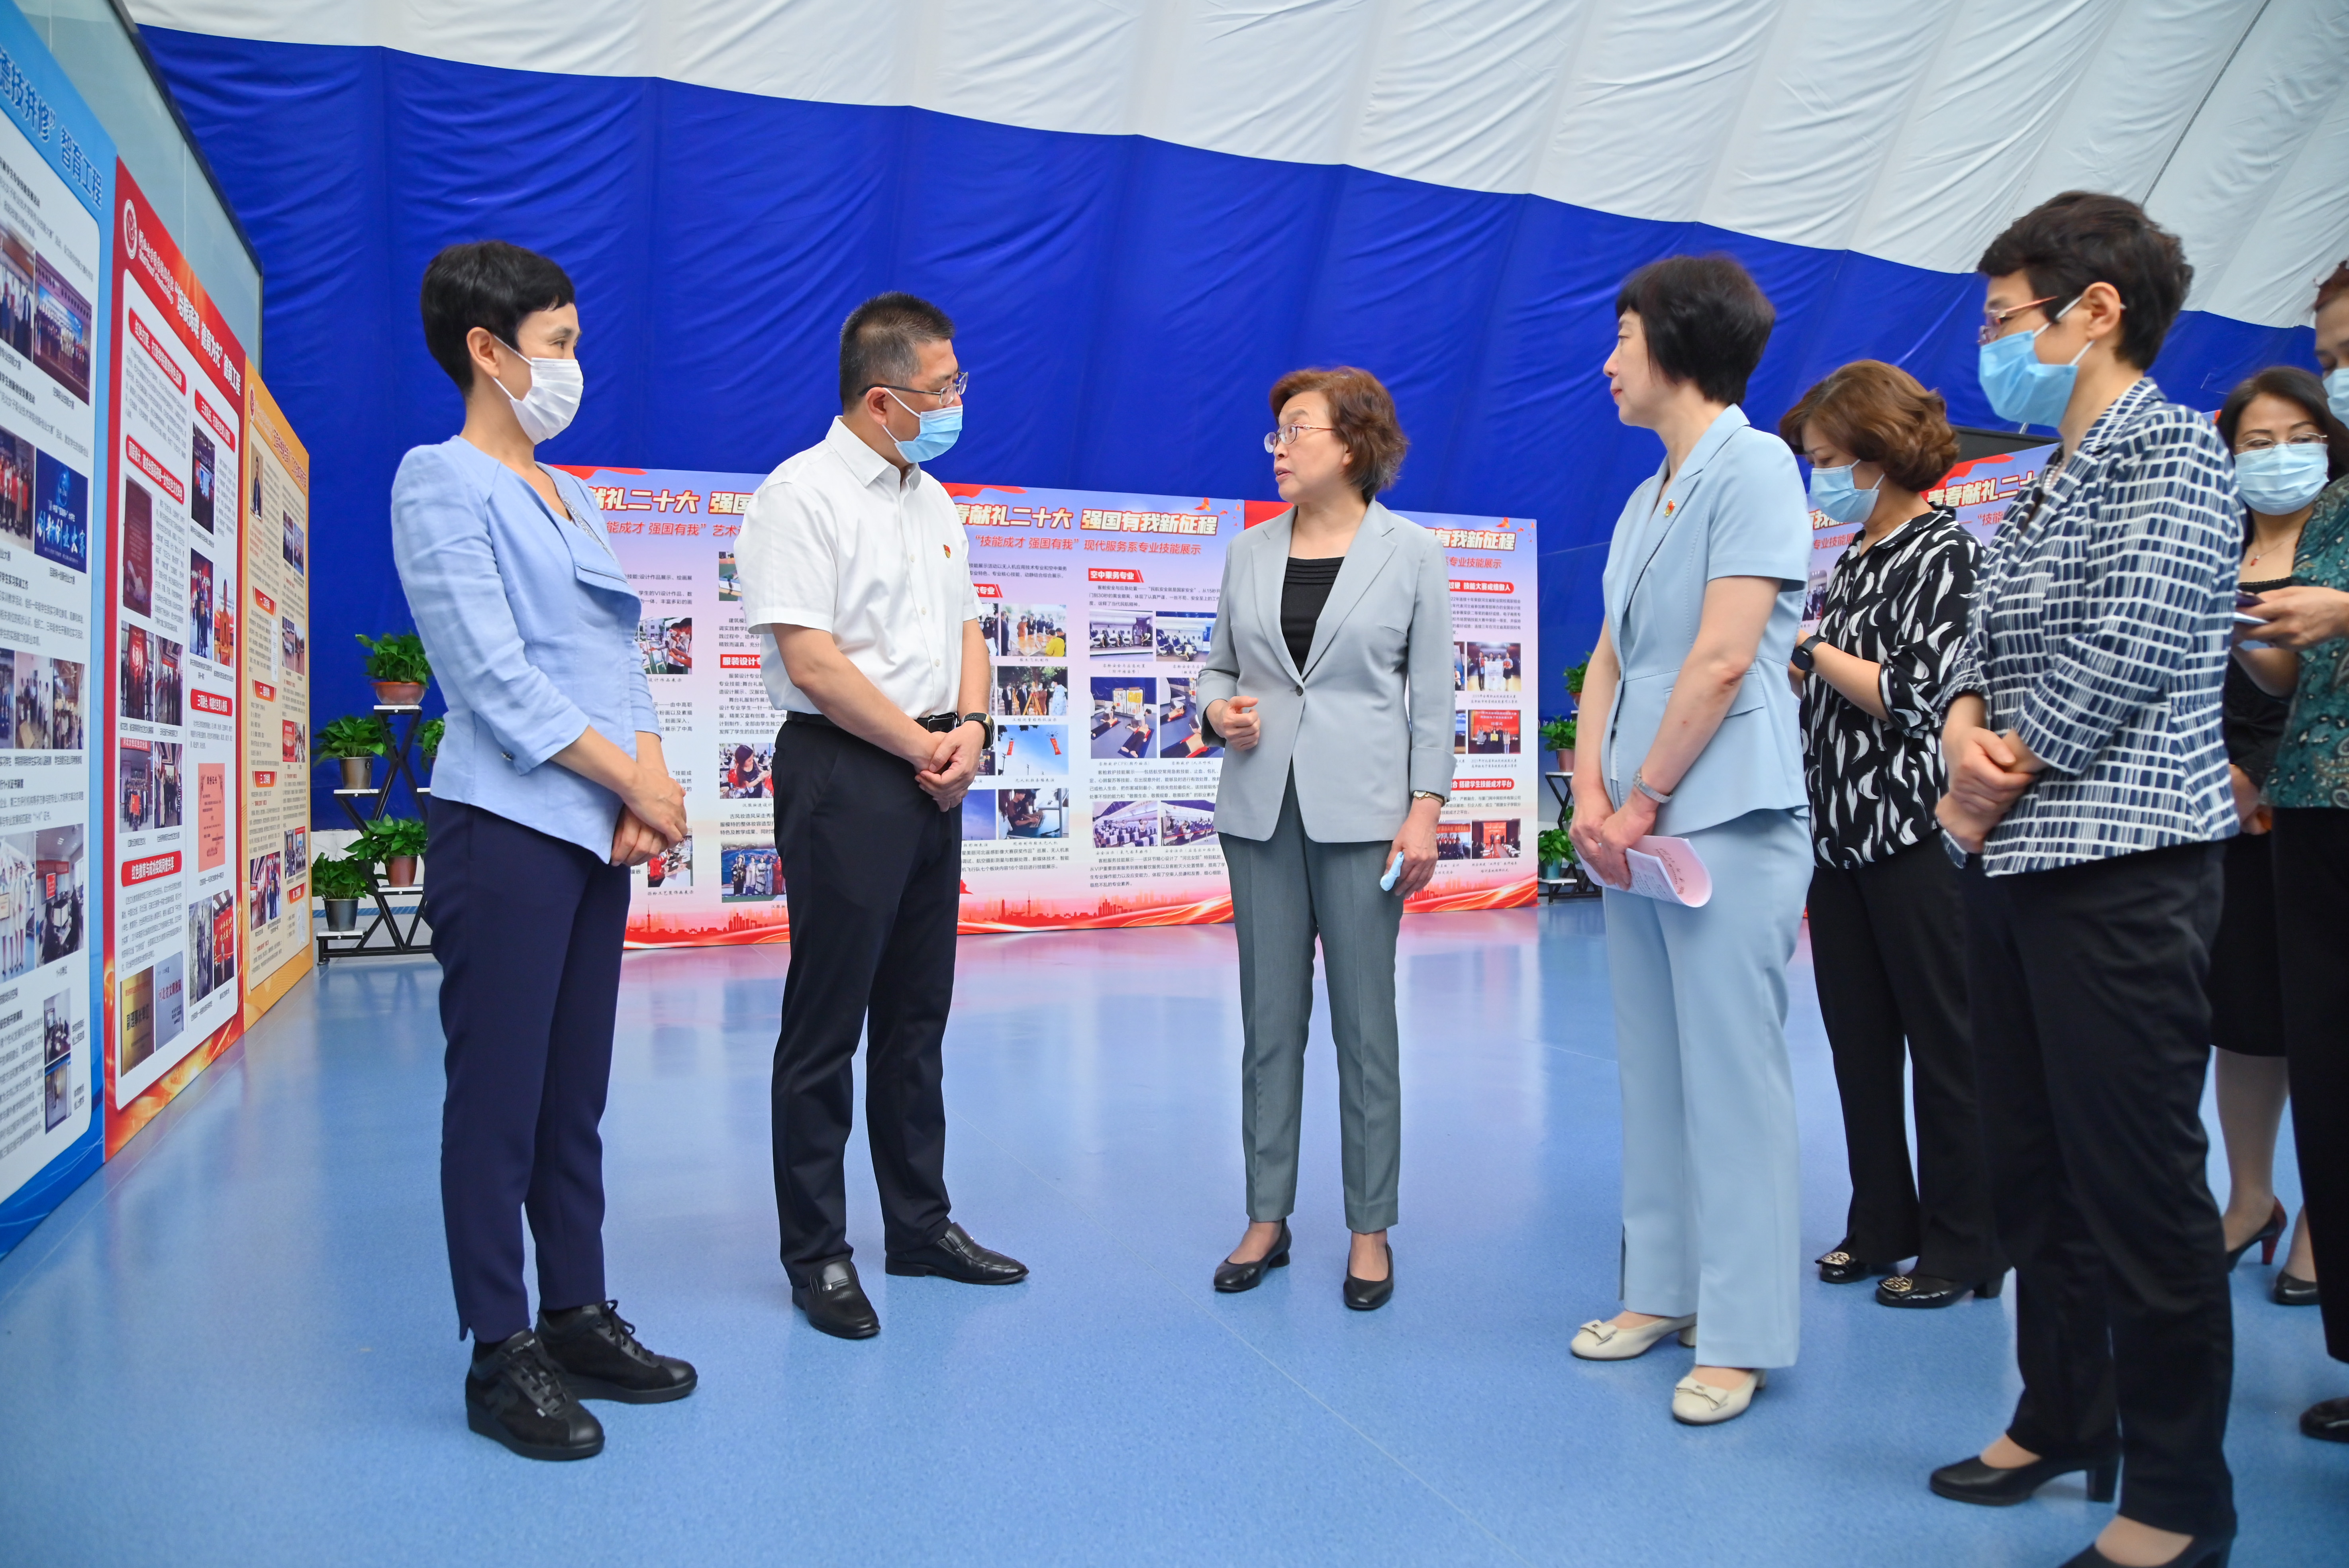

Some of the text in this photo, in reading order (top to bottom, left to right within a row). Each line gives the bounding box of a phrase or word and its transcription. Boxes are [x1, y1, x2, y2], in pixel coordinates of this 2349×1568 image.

[61, 125, 102, 210] 智育工程
[224, 353, 241, 396] 德育工程
[649, 523, 706, 536] 强国有我”
[1080, 509, 1219, 536] 强国有我新征程
[975, 535, 1202, 555] “技能成才 强国有我” 现代服务系专业技能展示
[1090, 570, 1134, 580] 空中乘务专业
[1464, 582, 1511, 592] 技能大赛成绩傲人
[1459, 780, 1512, 788] 搭建学生技能成才平台
